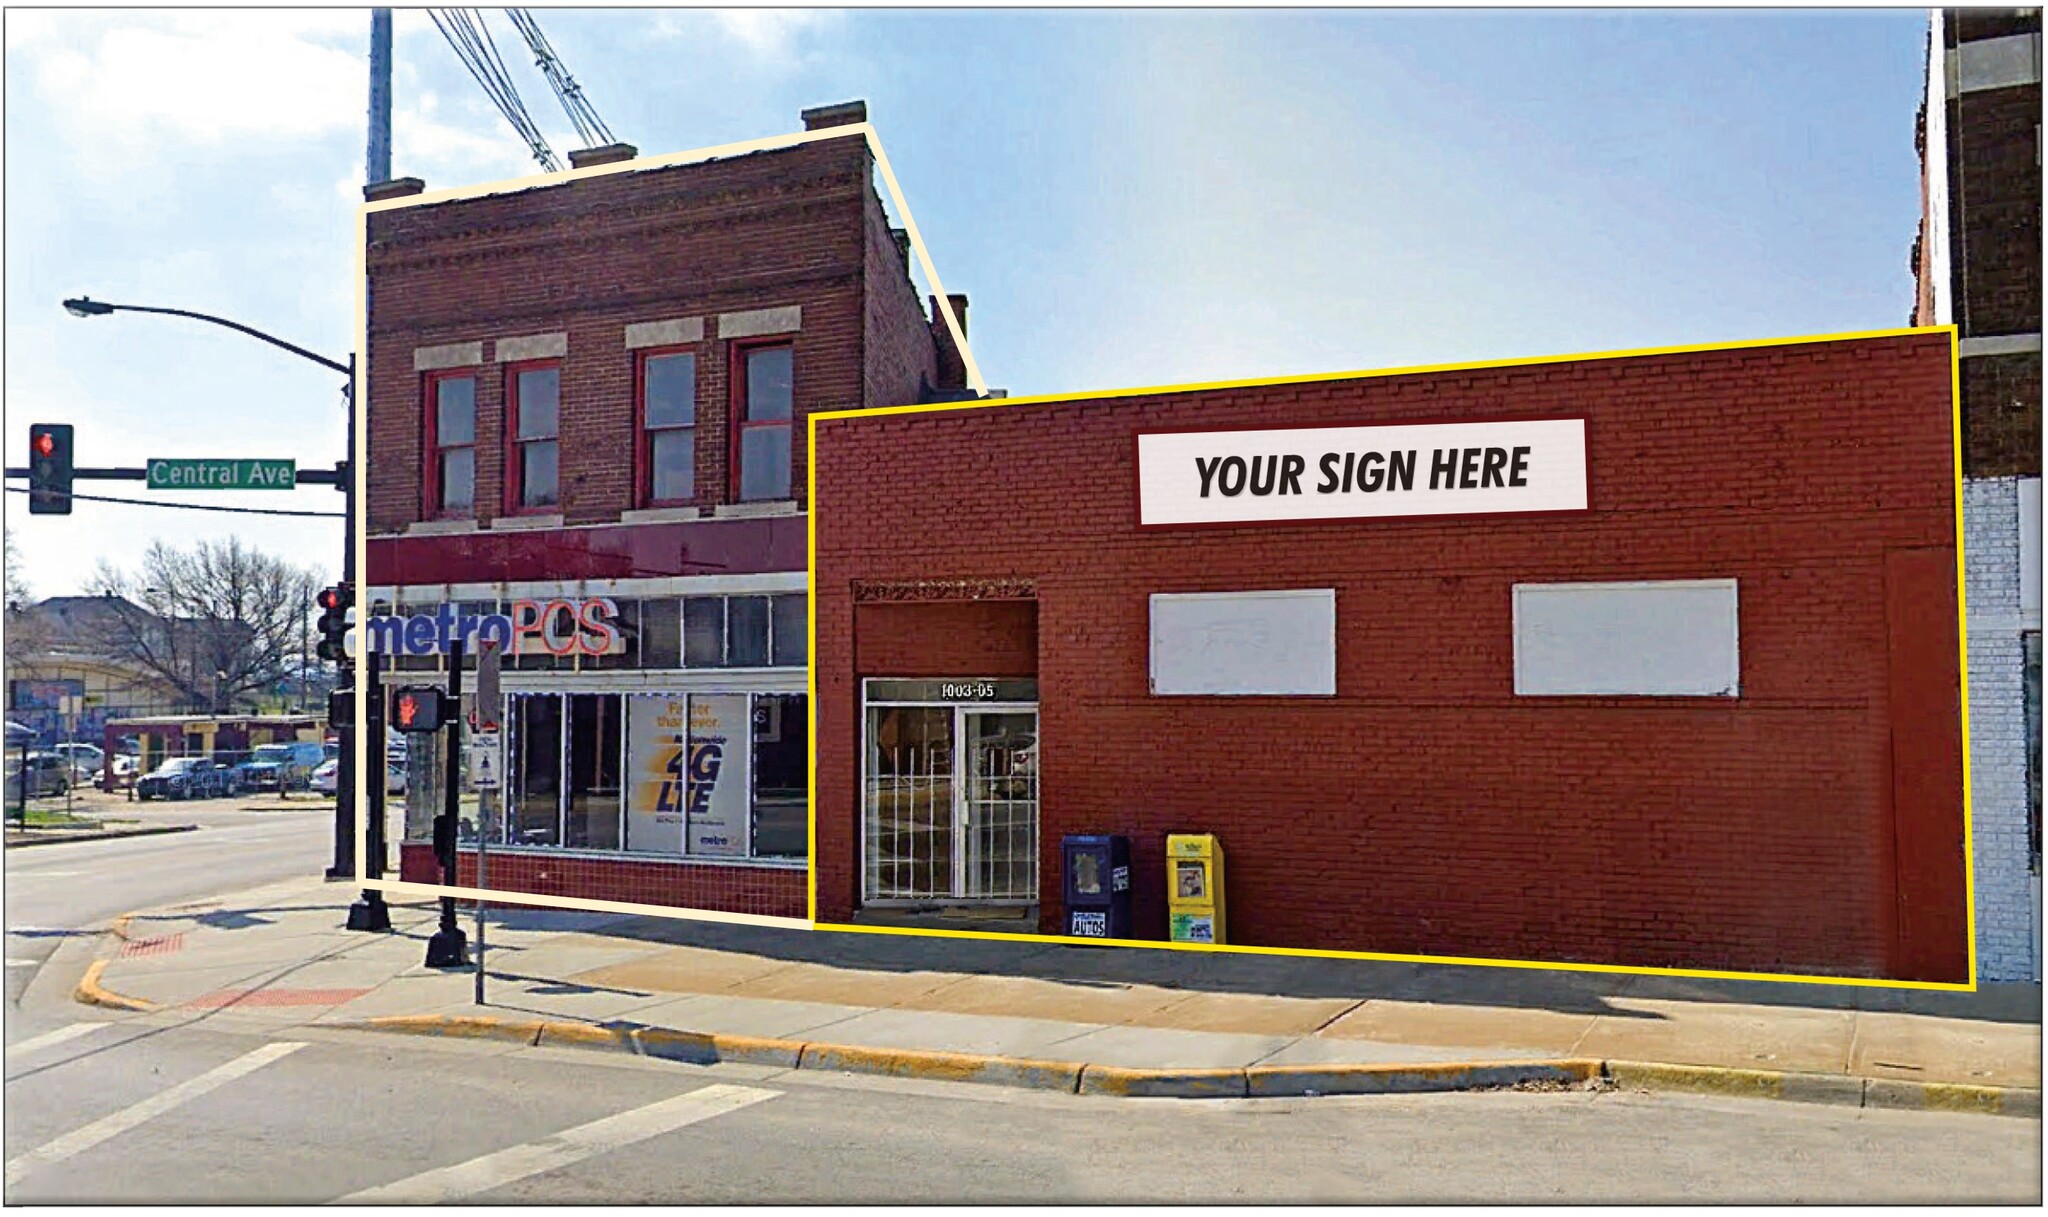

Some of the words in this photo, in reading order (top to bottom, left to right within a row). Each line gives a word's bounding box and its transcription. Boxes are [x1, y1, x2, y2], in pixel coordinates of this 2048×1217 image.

[153, 461, 239, 484] Central
[247, 461, 291, 484] Ave
[1195, 454, 1305, 498] YOUR
[1316, 449, 1418, 494] SIGN
[1428, 446, 1532, 490] HERE
[366, 598, 622, 656] metroPCS
[942, 683, 995, 698] 1003-05
[667, 744, 722, 782] 4G
[656, 781, 715, 813] LTE
[1073, 921, 1105, 935] AUTOS
